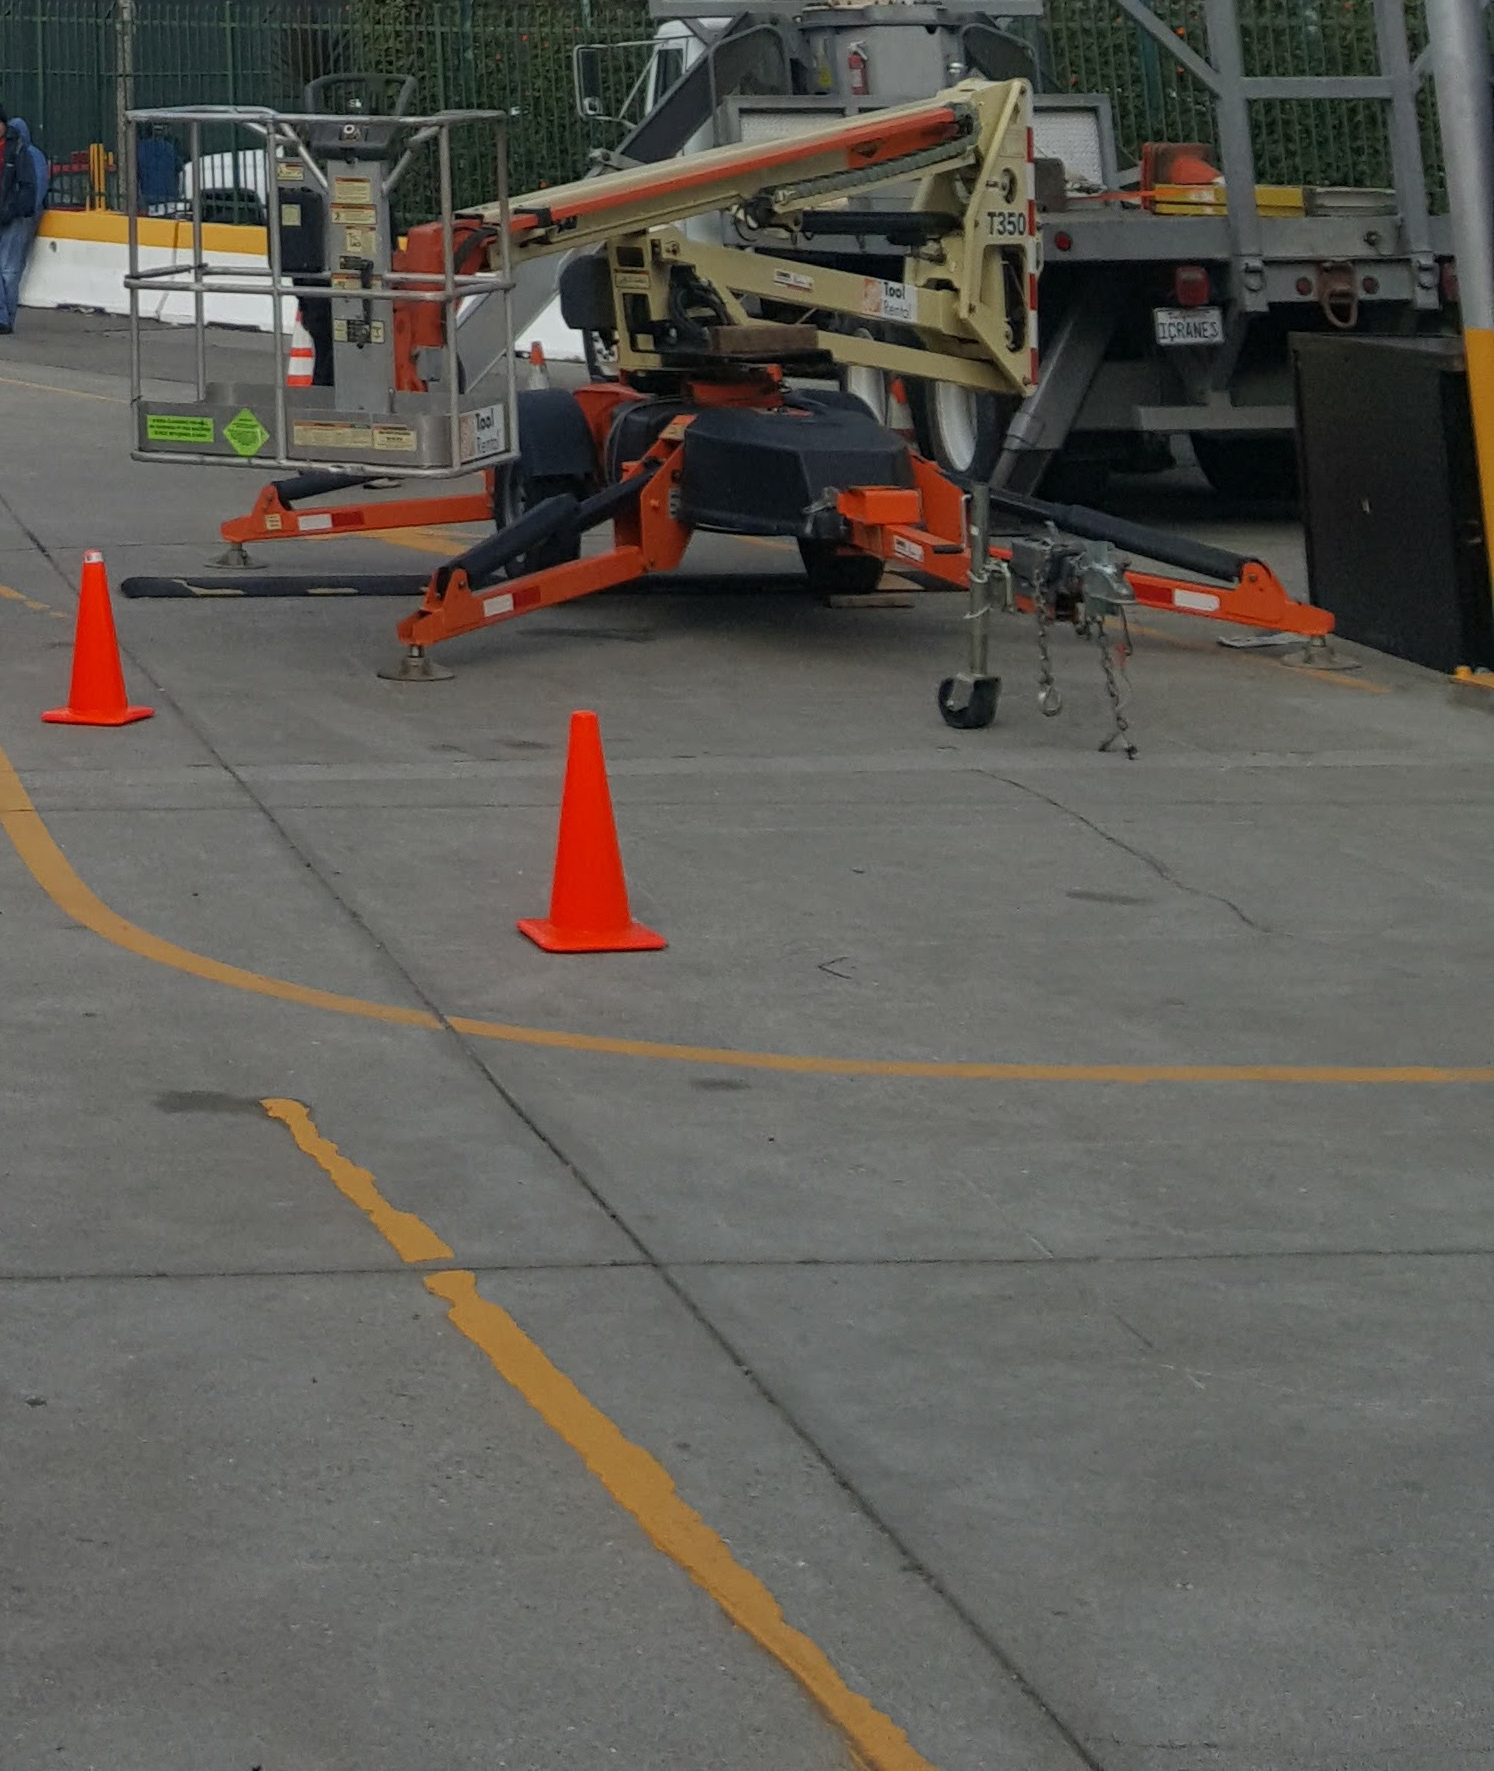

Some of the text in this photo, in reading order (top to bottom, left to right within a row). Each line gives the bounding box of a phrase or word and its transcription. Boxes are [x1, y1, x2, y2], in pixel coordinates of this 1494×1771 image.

[986, 211, 1027, 236] T350
[883, 281, 906, 300] Tool
[475, 407, 495, 432] Tool
